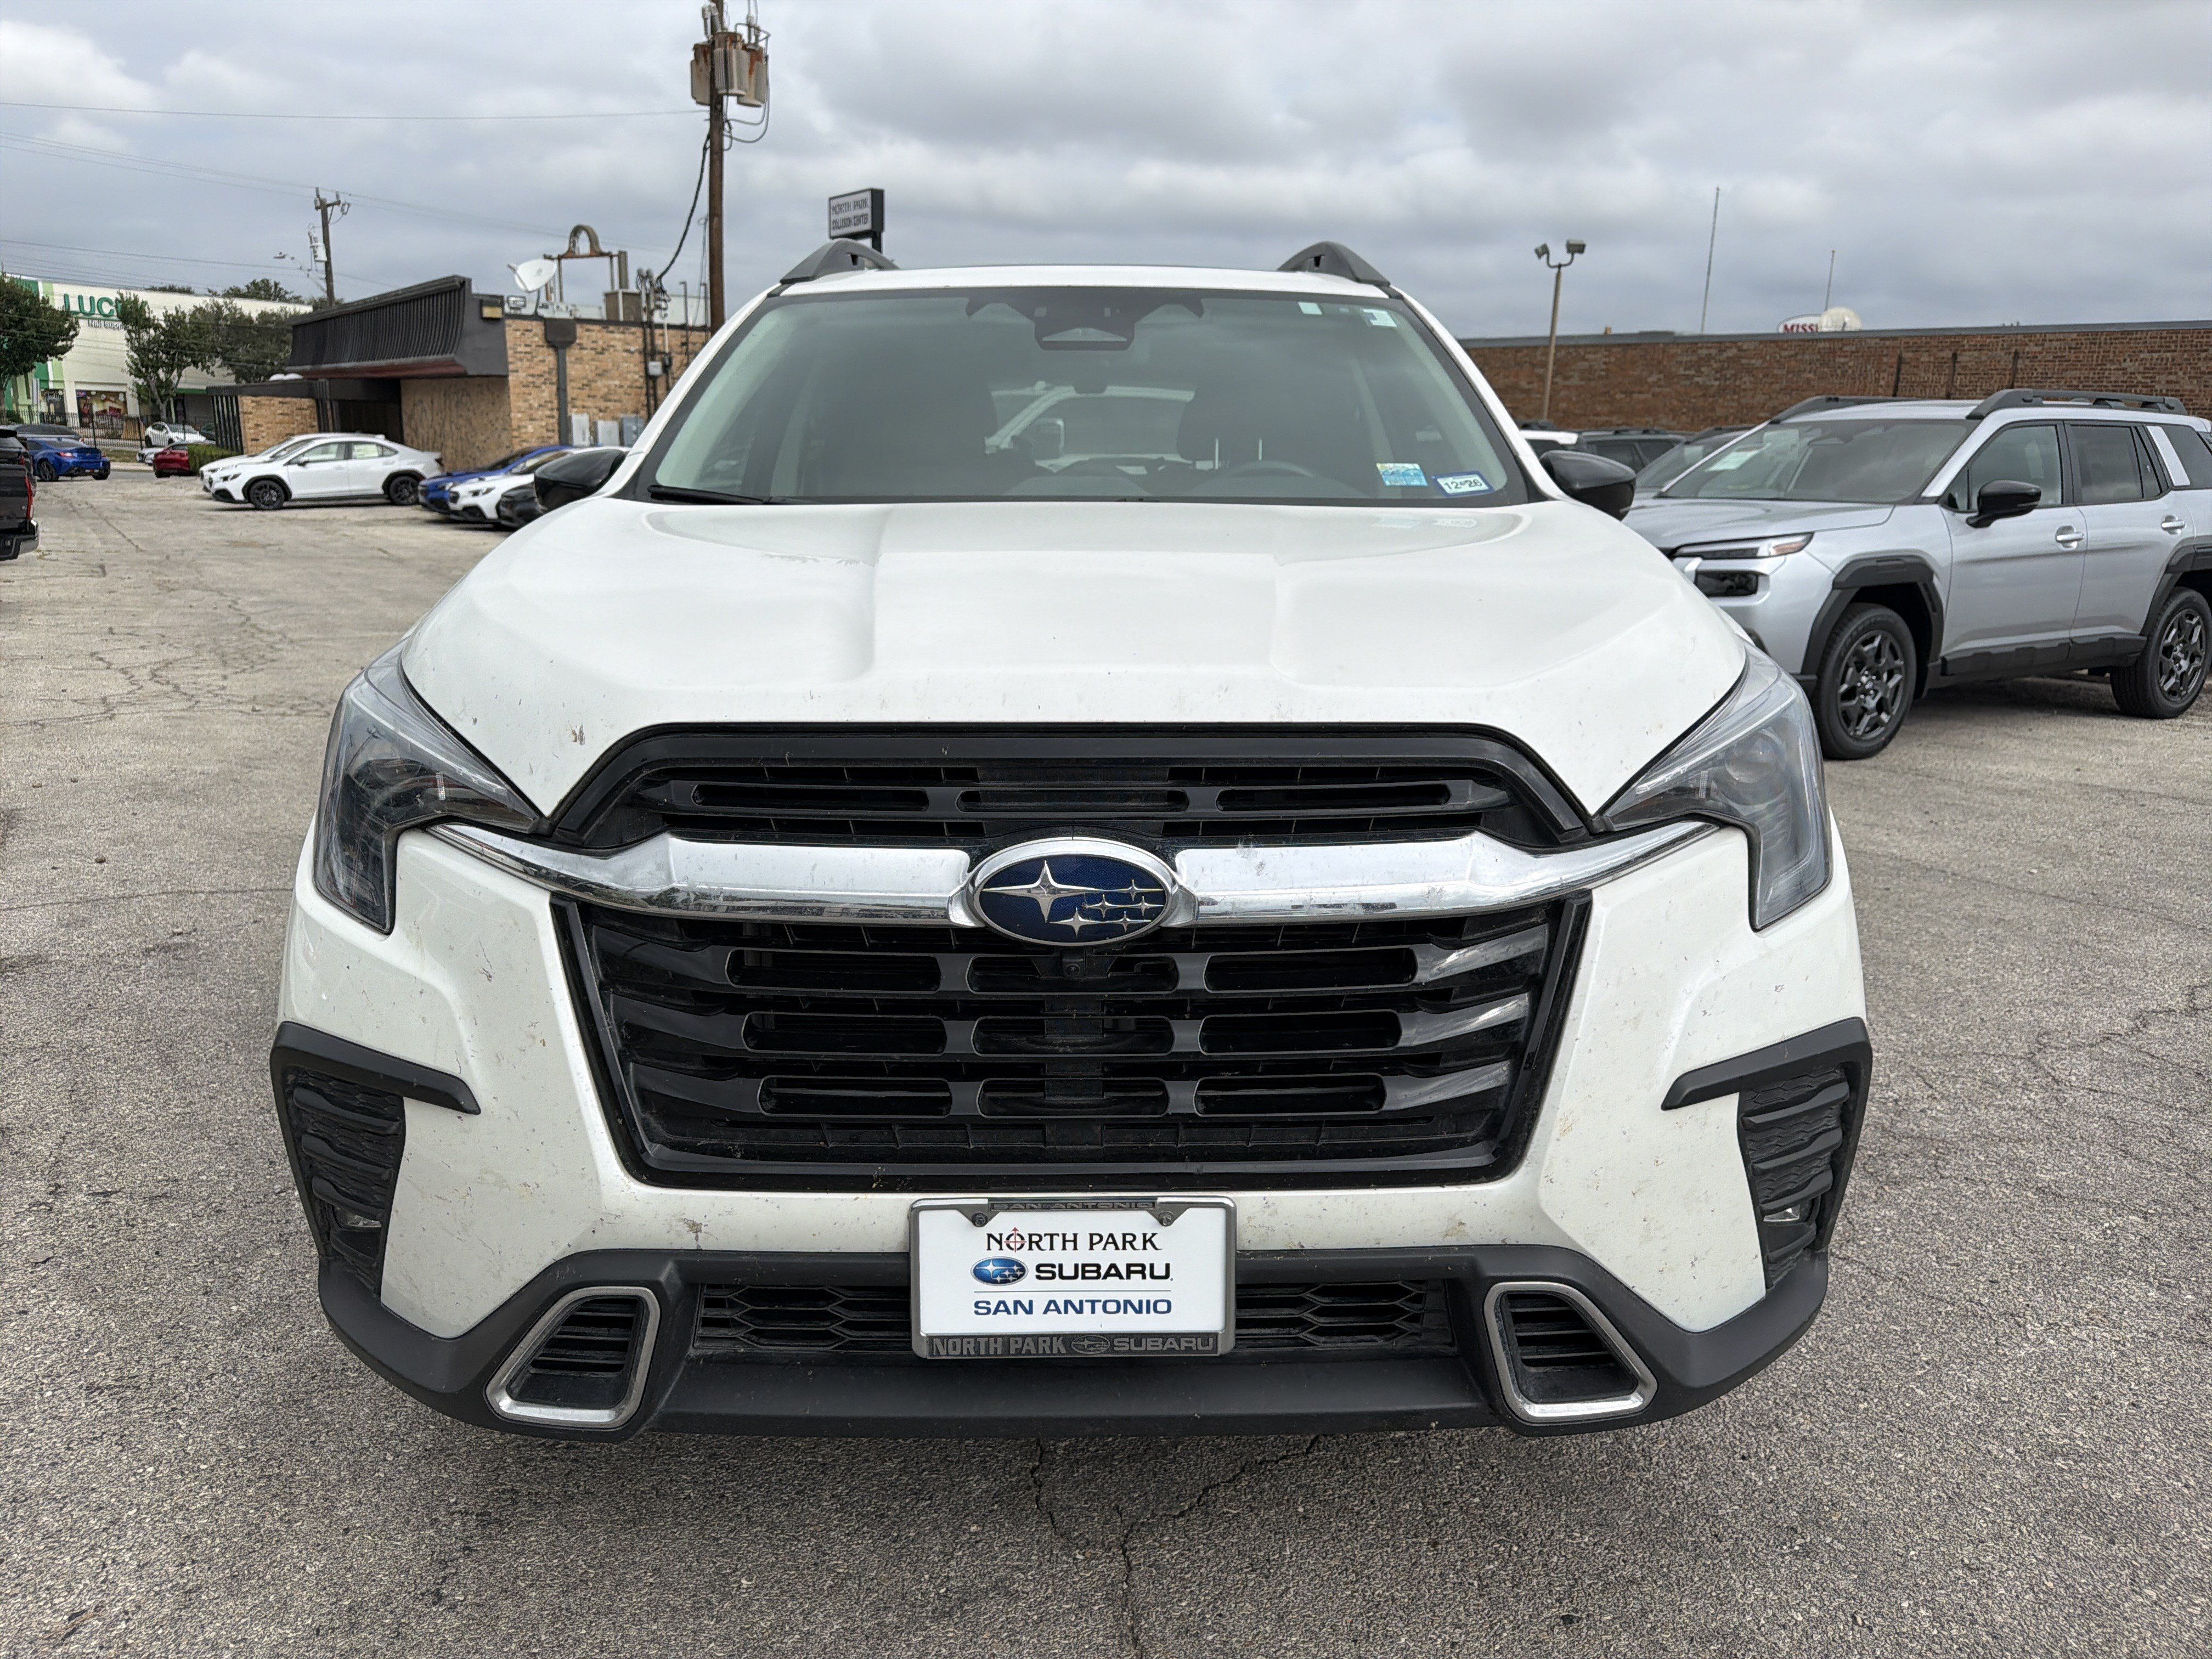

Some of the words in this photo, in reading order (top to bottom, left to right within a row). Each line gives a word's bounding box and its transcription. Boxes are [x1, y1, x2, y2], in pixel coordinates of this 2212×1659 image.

[64, 293, 144, 317] LUC
[992, 1202, 1042, 1210] SAN
[1051, 1201, 1155, 1210] ANTONIO
[986, 1227, 1079, 1252] NORTH
[1088, 1232, 1163, 1251] PARK
[1035, 1263, 1171, 1280] SUBARU
[974, 1299, 1034, 1316] SAN
[1042, 1299, 1172, 1314] ANTONIO
[933, 1337, 1003, 1356] NORTH
[1009, 1336, 1066, 1355] PARK
[1113, 1338, 1214, 1351] SUBARU
